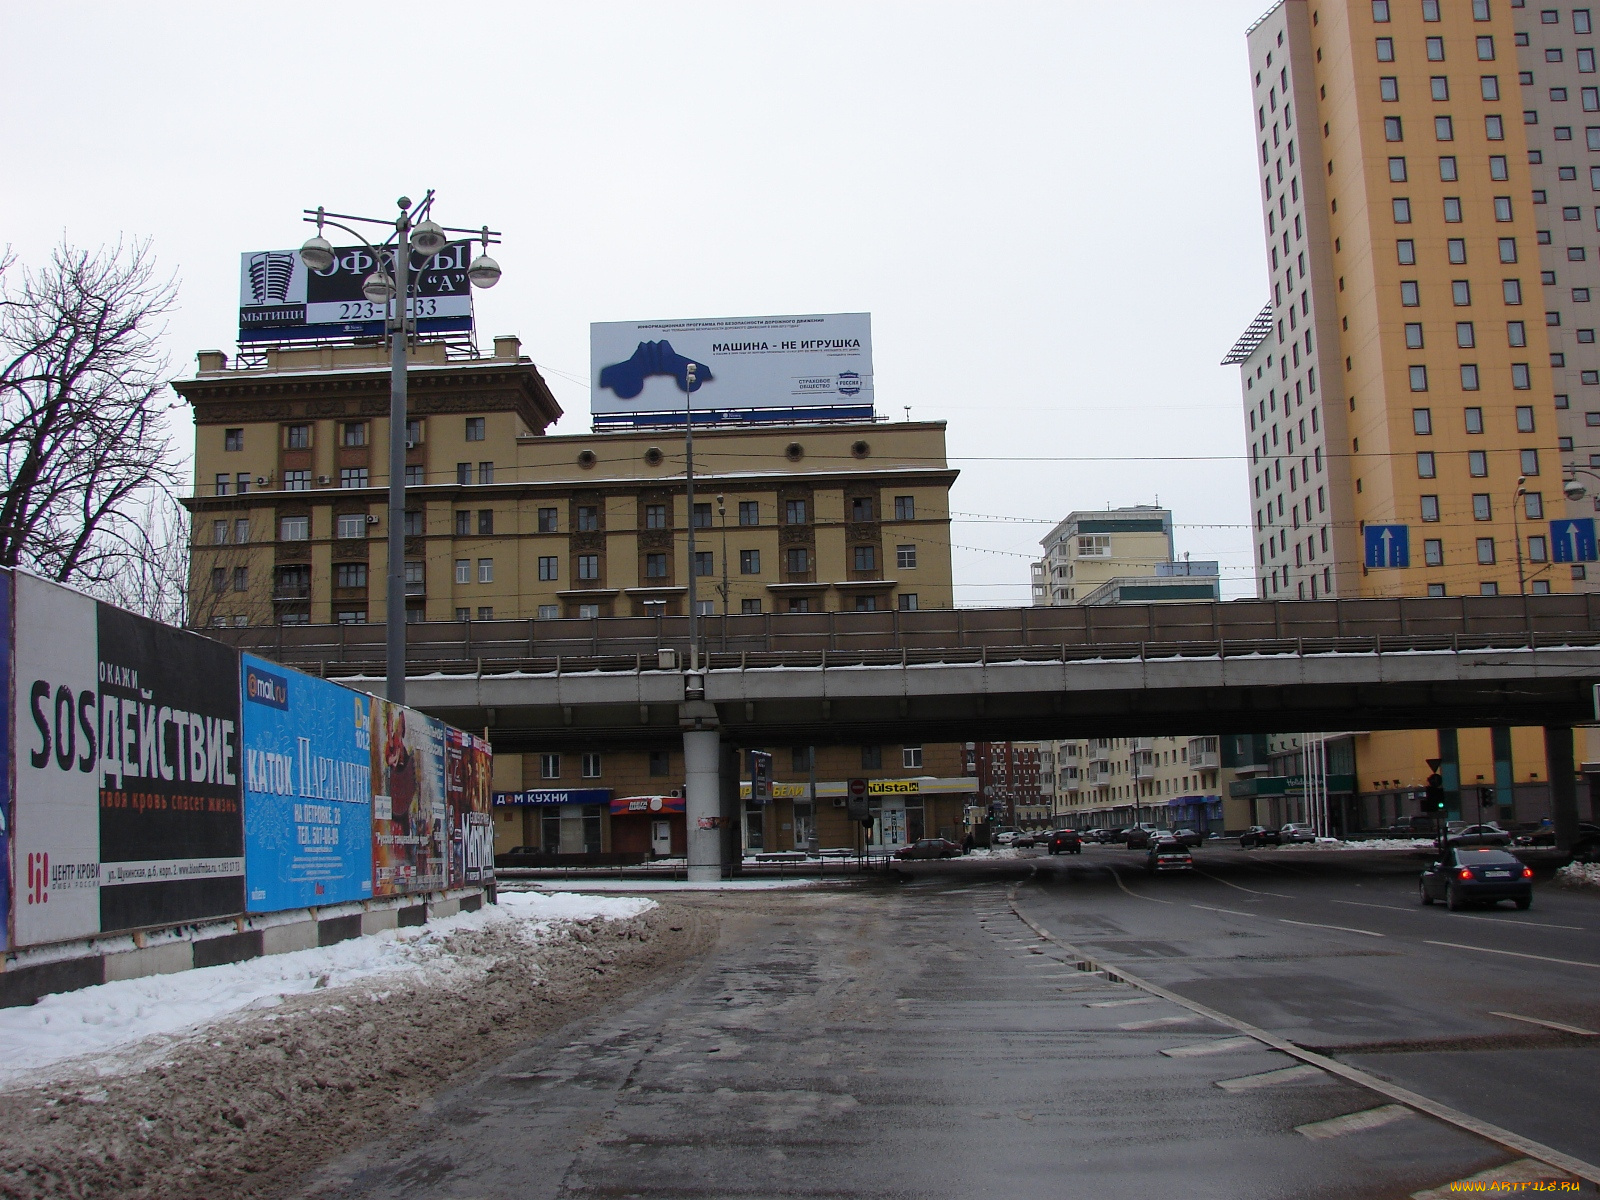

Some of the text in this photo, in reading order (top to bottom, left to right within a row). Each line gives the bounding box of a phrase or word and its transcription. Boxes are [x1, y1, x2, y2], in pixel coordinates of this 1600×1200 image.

[241, 310, 304, 323] МЫТИЩИ
[712, 342, 769, 352] МАШИНА
[781, 341, 797, 350] НЕ
[801, 339, 861, 349] ИГРУШКА
[100, 661, 138, 690] ОКАЖИ
[247, 748, 293, 796] КАТОК
[527, 792, 569, 804] КУХНИ
[772, 785, 805, 798] БЕЛИ
[294, 803, 303, 823] НА
[52, 863, 100, 884] ЦЕНТР КРОВИ
